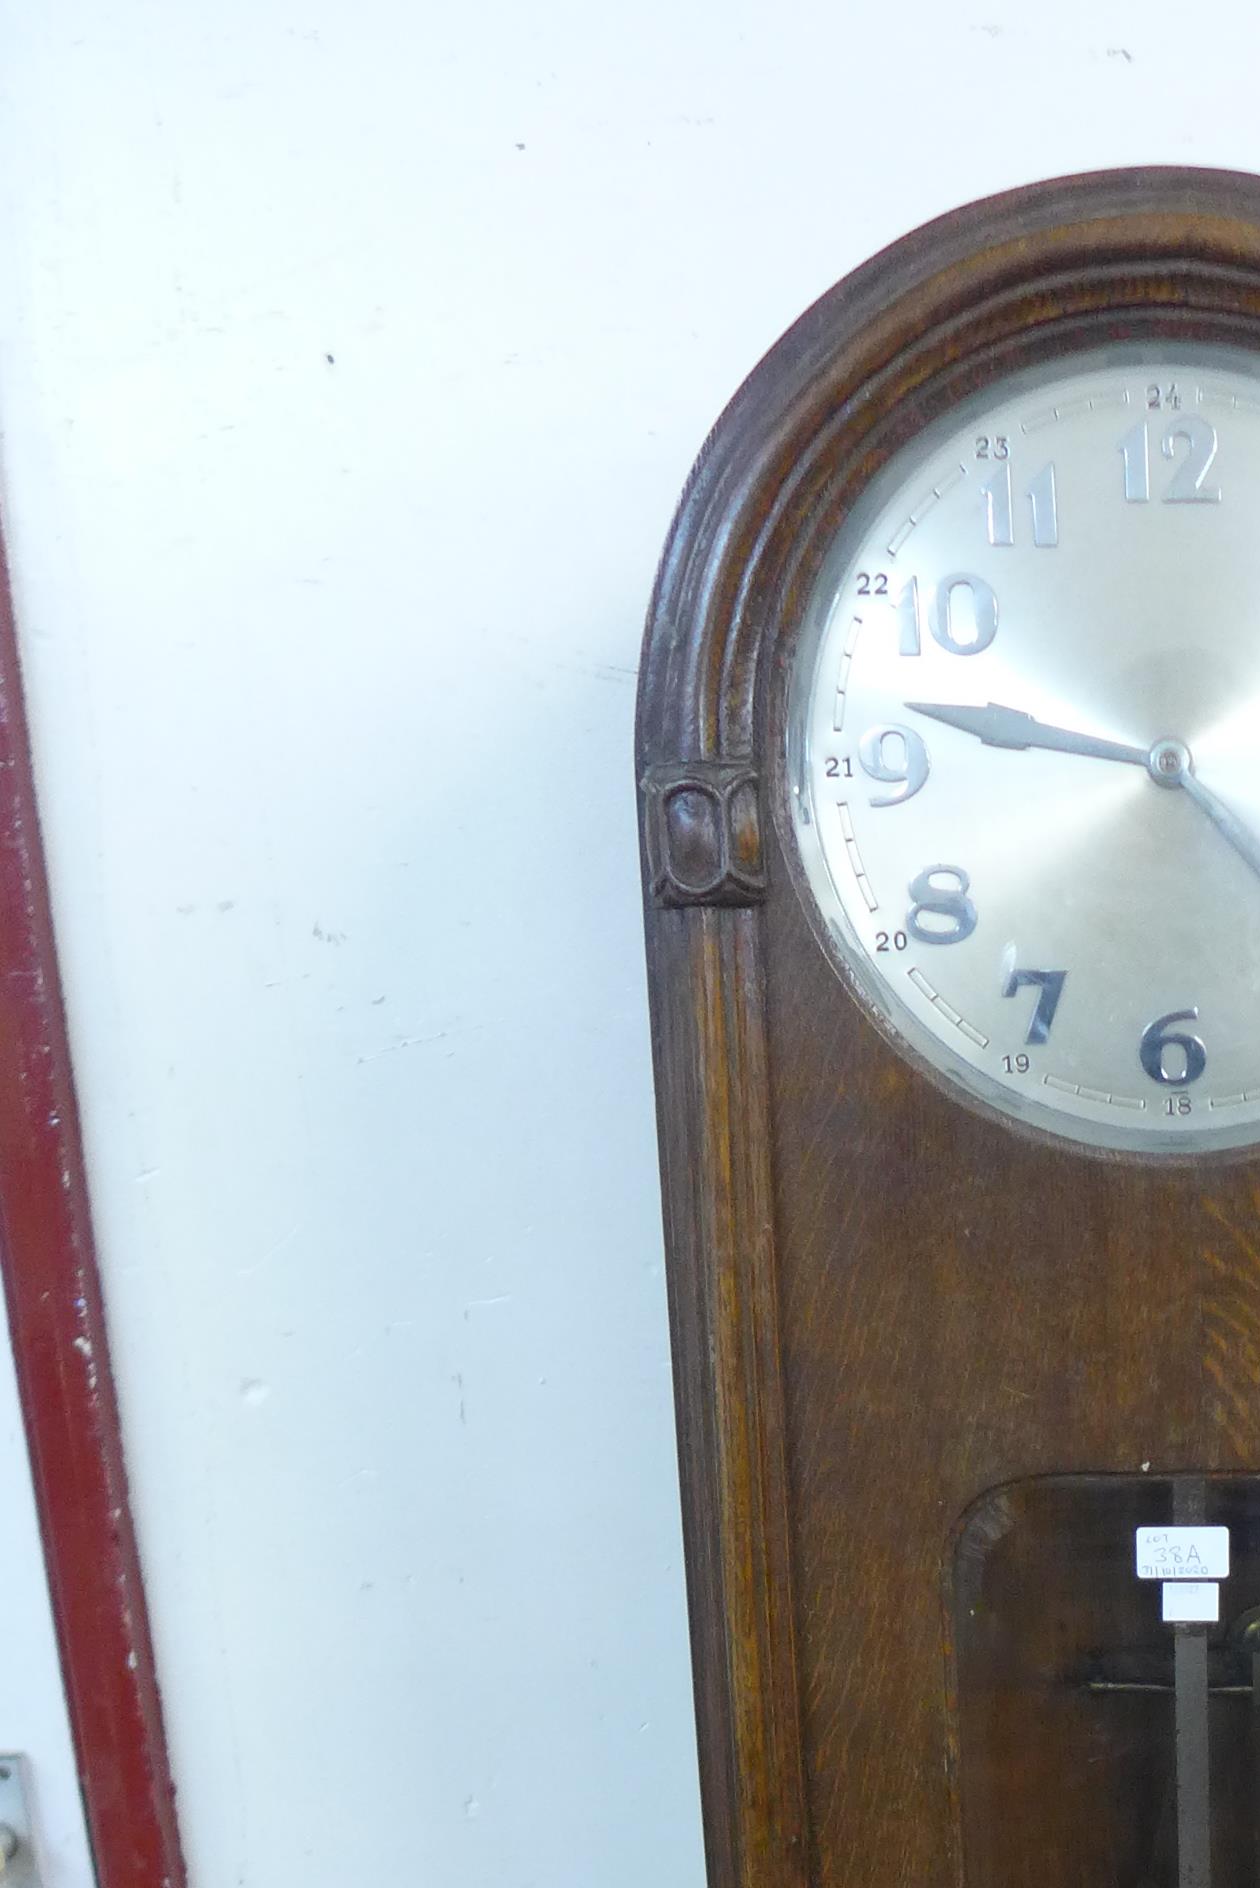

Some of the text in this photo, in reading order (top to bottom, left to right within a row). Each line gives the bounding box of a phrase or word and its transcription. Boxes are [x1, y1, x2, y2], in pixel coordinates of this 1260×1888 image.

[1146, 383, 1182, 410] 24
[975, 435, 1010, 460] 23
[1118, 413, 1222, 504] 12
[980, 462, 1059, 548] 11
[856, 573, 889, 595] 22
[890, 571, 1000, 656] 10
[825, 757, 854, 778] 21
[858, 722, 931, 808] 9
[905, 863, 978, 945] 8
[875, 931, 908, 952] 20
[1002, 968, 1069, 1045] 7
[1139, 1006, 1207, 1087] 6
[1001, 1053, 1031, 1075] 19
[1163, 1096, 1193, 1116] 18
[1154, 1545, 1201, 1563] 38A
